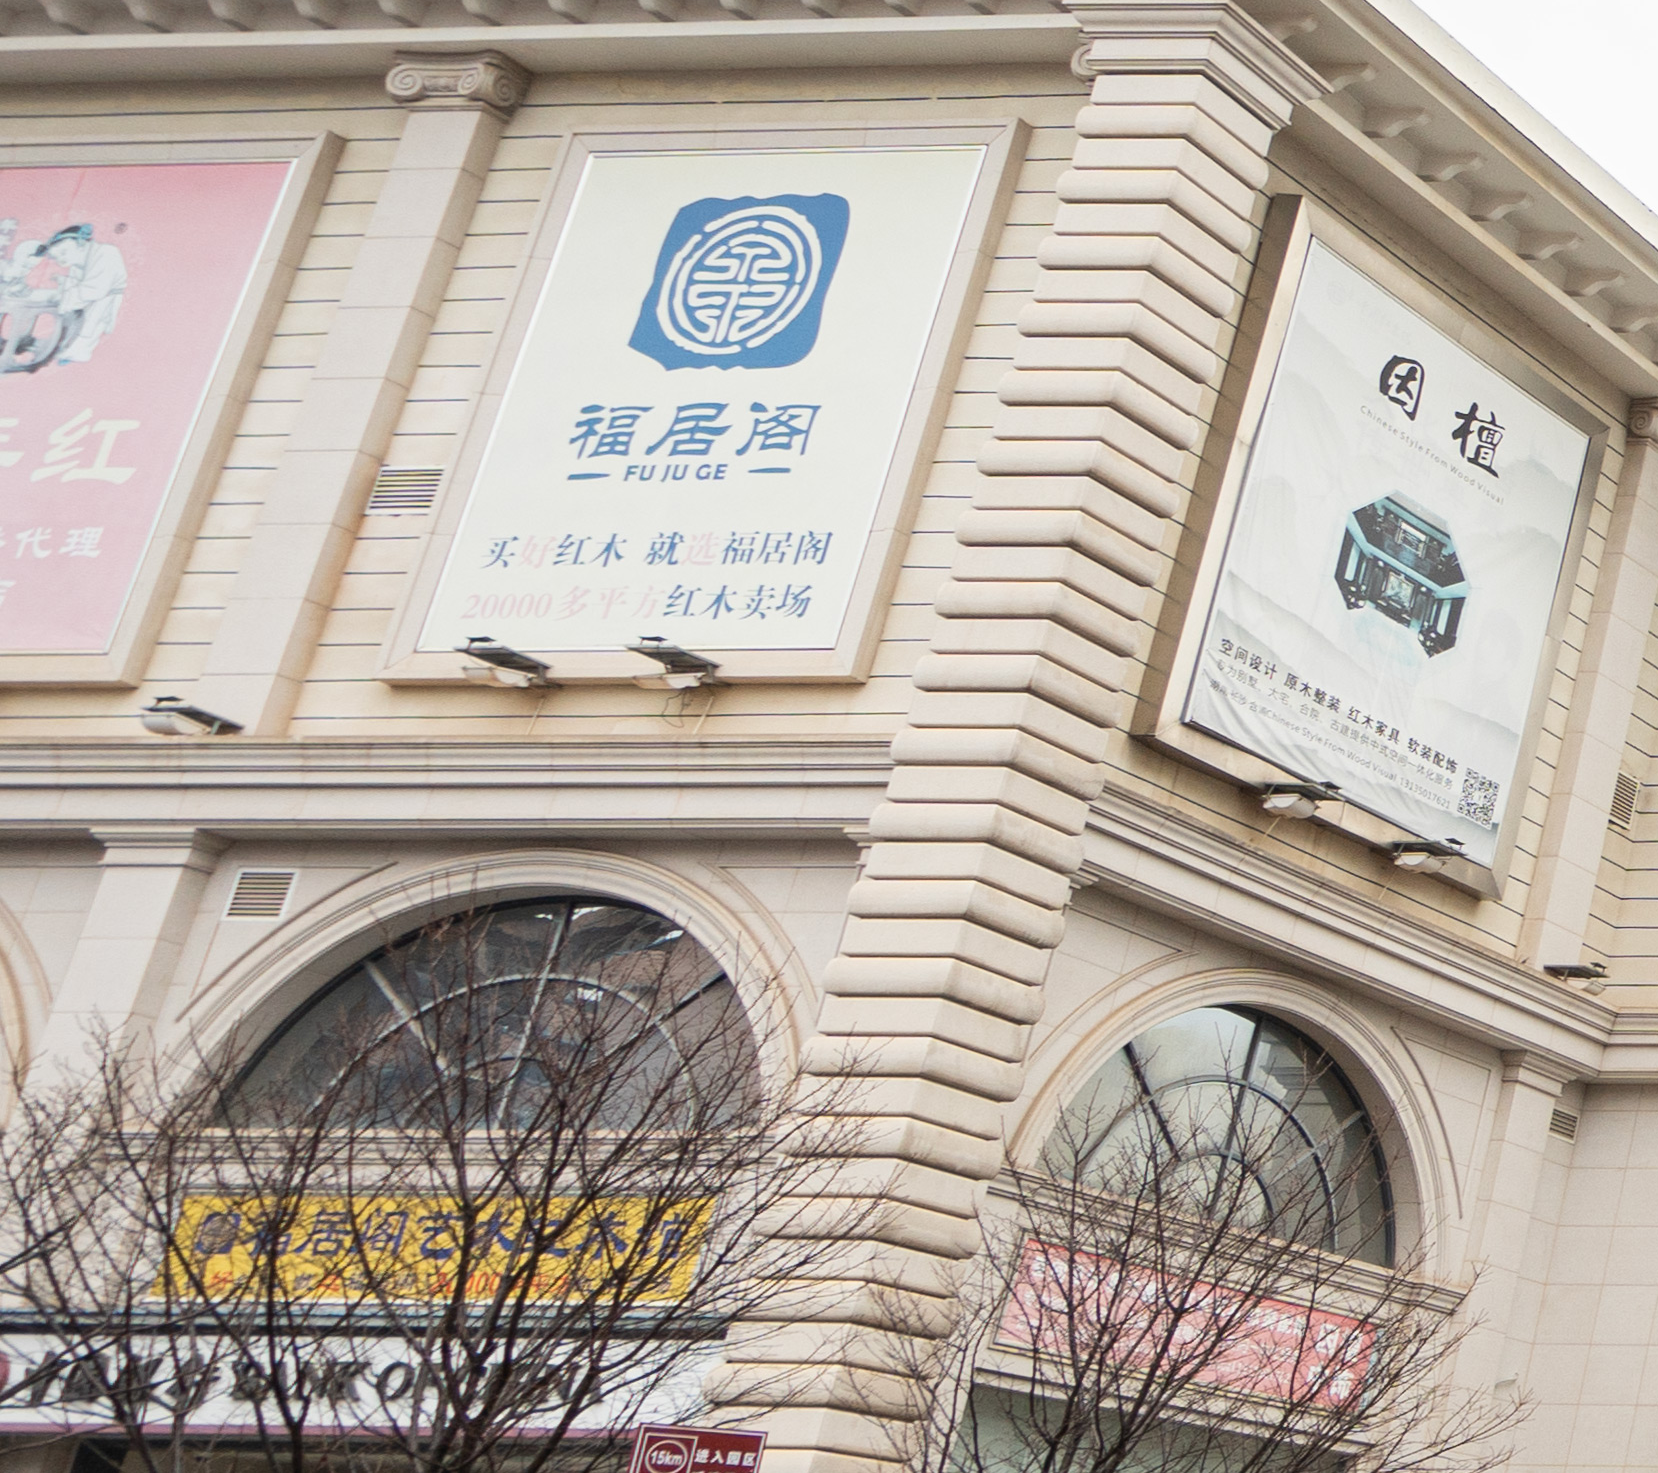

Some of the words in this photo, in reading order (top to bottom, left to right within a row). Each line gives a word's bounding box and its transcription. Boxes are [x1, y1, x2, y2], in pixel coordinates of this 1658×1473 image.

[568, 402, 822, 459] 福居阁
[1360, 405, 1398, 436] Chinese
[1400, 431, 1424, 453] Style
[1425, 448, 1448, 469] From
[1449, 463, 1476, 486] Wood
[1477, 482, 1505, 505] Visual
[623, 465, 657, 481] FU
[660, 464, 689, 482] JU
[695, 464, 729, 480] GE
[0, 526, 104, 559] 代理
[480, 532, 628, 569] 买好红木
[643, 531, 834, 567] 就选福居阁
[1218, 638, 1278, 680] 空间设计
[1283, 672, 1341, 713] 原木整装
[1347, 706, 1401, 744] 红木家具
[1407, 737, 1459, 775] 软装配饰
[651, 1450, 683, 1466] 15km
[694, 1449, 757, 1466] 进入园区
